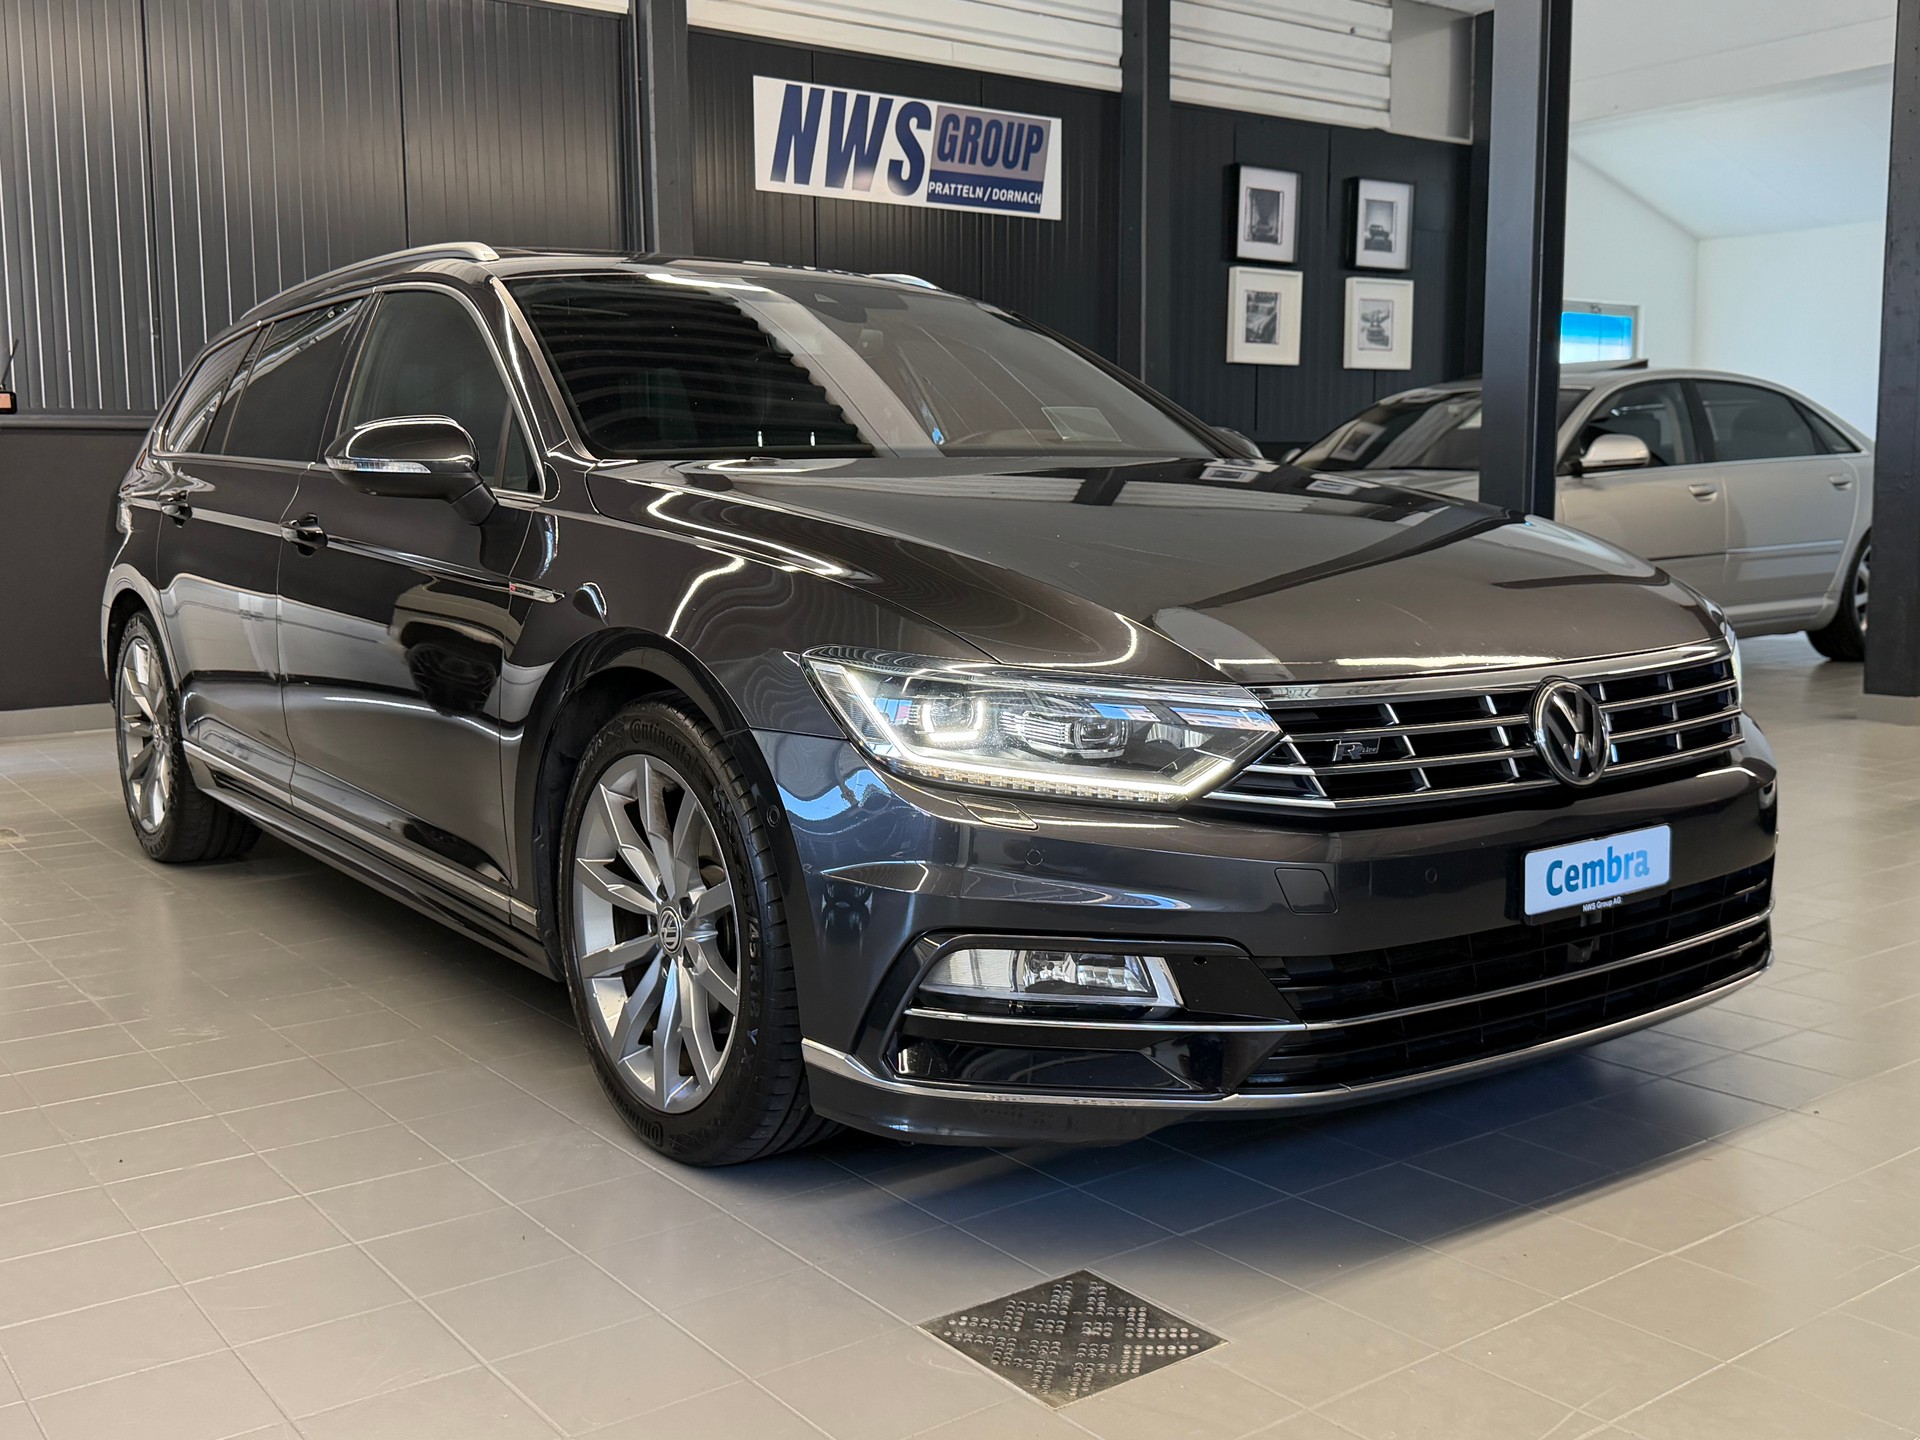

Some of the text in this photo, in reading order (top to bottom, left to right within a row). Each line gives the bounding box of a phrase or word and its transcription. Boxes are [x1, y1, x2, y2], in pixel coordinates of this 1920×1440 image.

[770, 84, 1043, 197] NWS GROUP
[1546, 846, 1649, 896] Cembra
[1582, 896, 1622, 912] NWS Group AG
